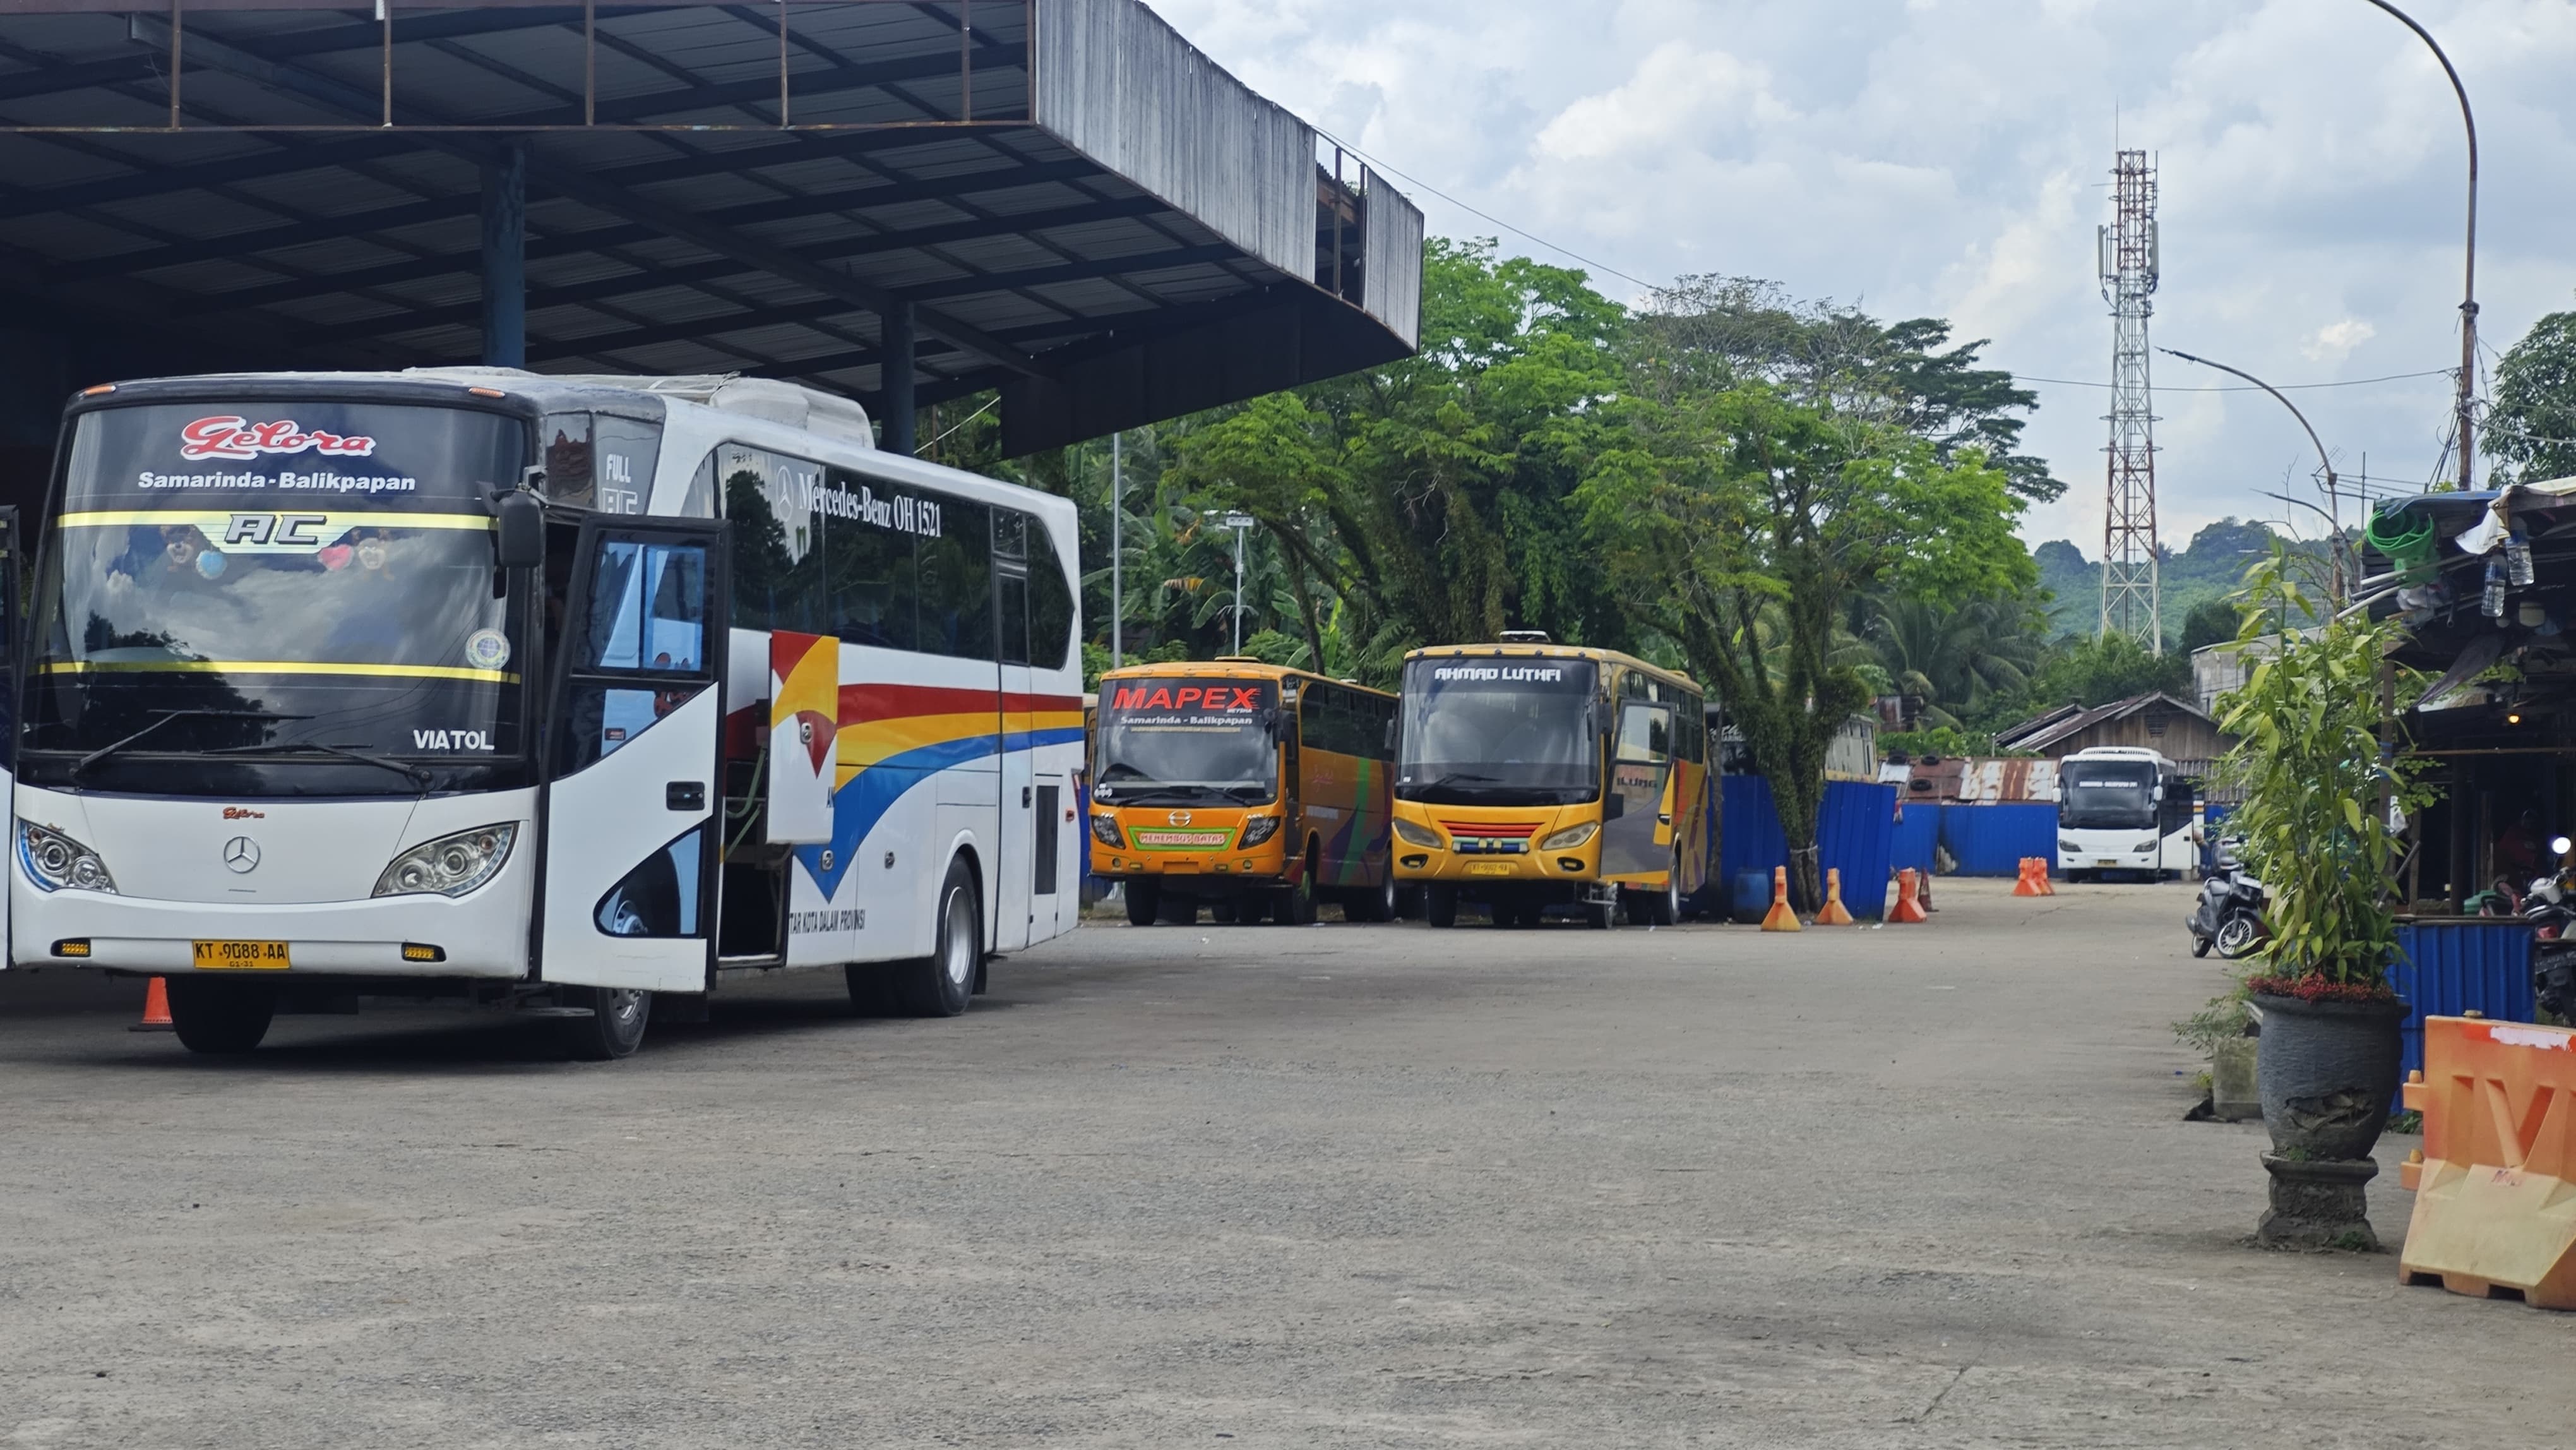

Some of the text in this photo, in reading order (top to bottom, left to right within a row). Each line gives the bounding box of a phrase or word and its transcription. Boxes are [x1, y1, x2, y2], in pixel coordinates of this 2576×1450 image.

[181, 416, 377, 460] Gelora
[606, 453, 631, 483] FULL
[138, 471, 265, 488] Samarinda
[280, 472, 416, 493] Balikpapan
[798, 472, 941, 537] Mercedes-Benz OH 1521
[224, 513, 328, 545] AC
[1434, 666, 1561, 682] AHMAD LUTHFI
[1112, 687, 1261, 709] MAPEX
[1121, 716, 1182, 724] Samarinda
[1190, 716, 1253, 726] Balikpapan
[802, 911, 818, 933] KOTA
[820, 910, 838, 932] DALAM
[840, 909, 866, 932] PROVINSI
[195, 943, 213, 959] KT
[267, 944, 285, 959] AA
